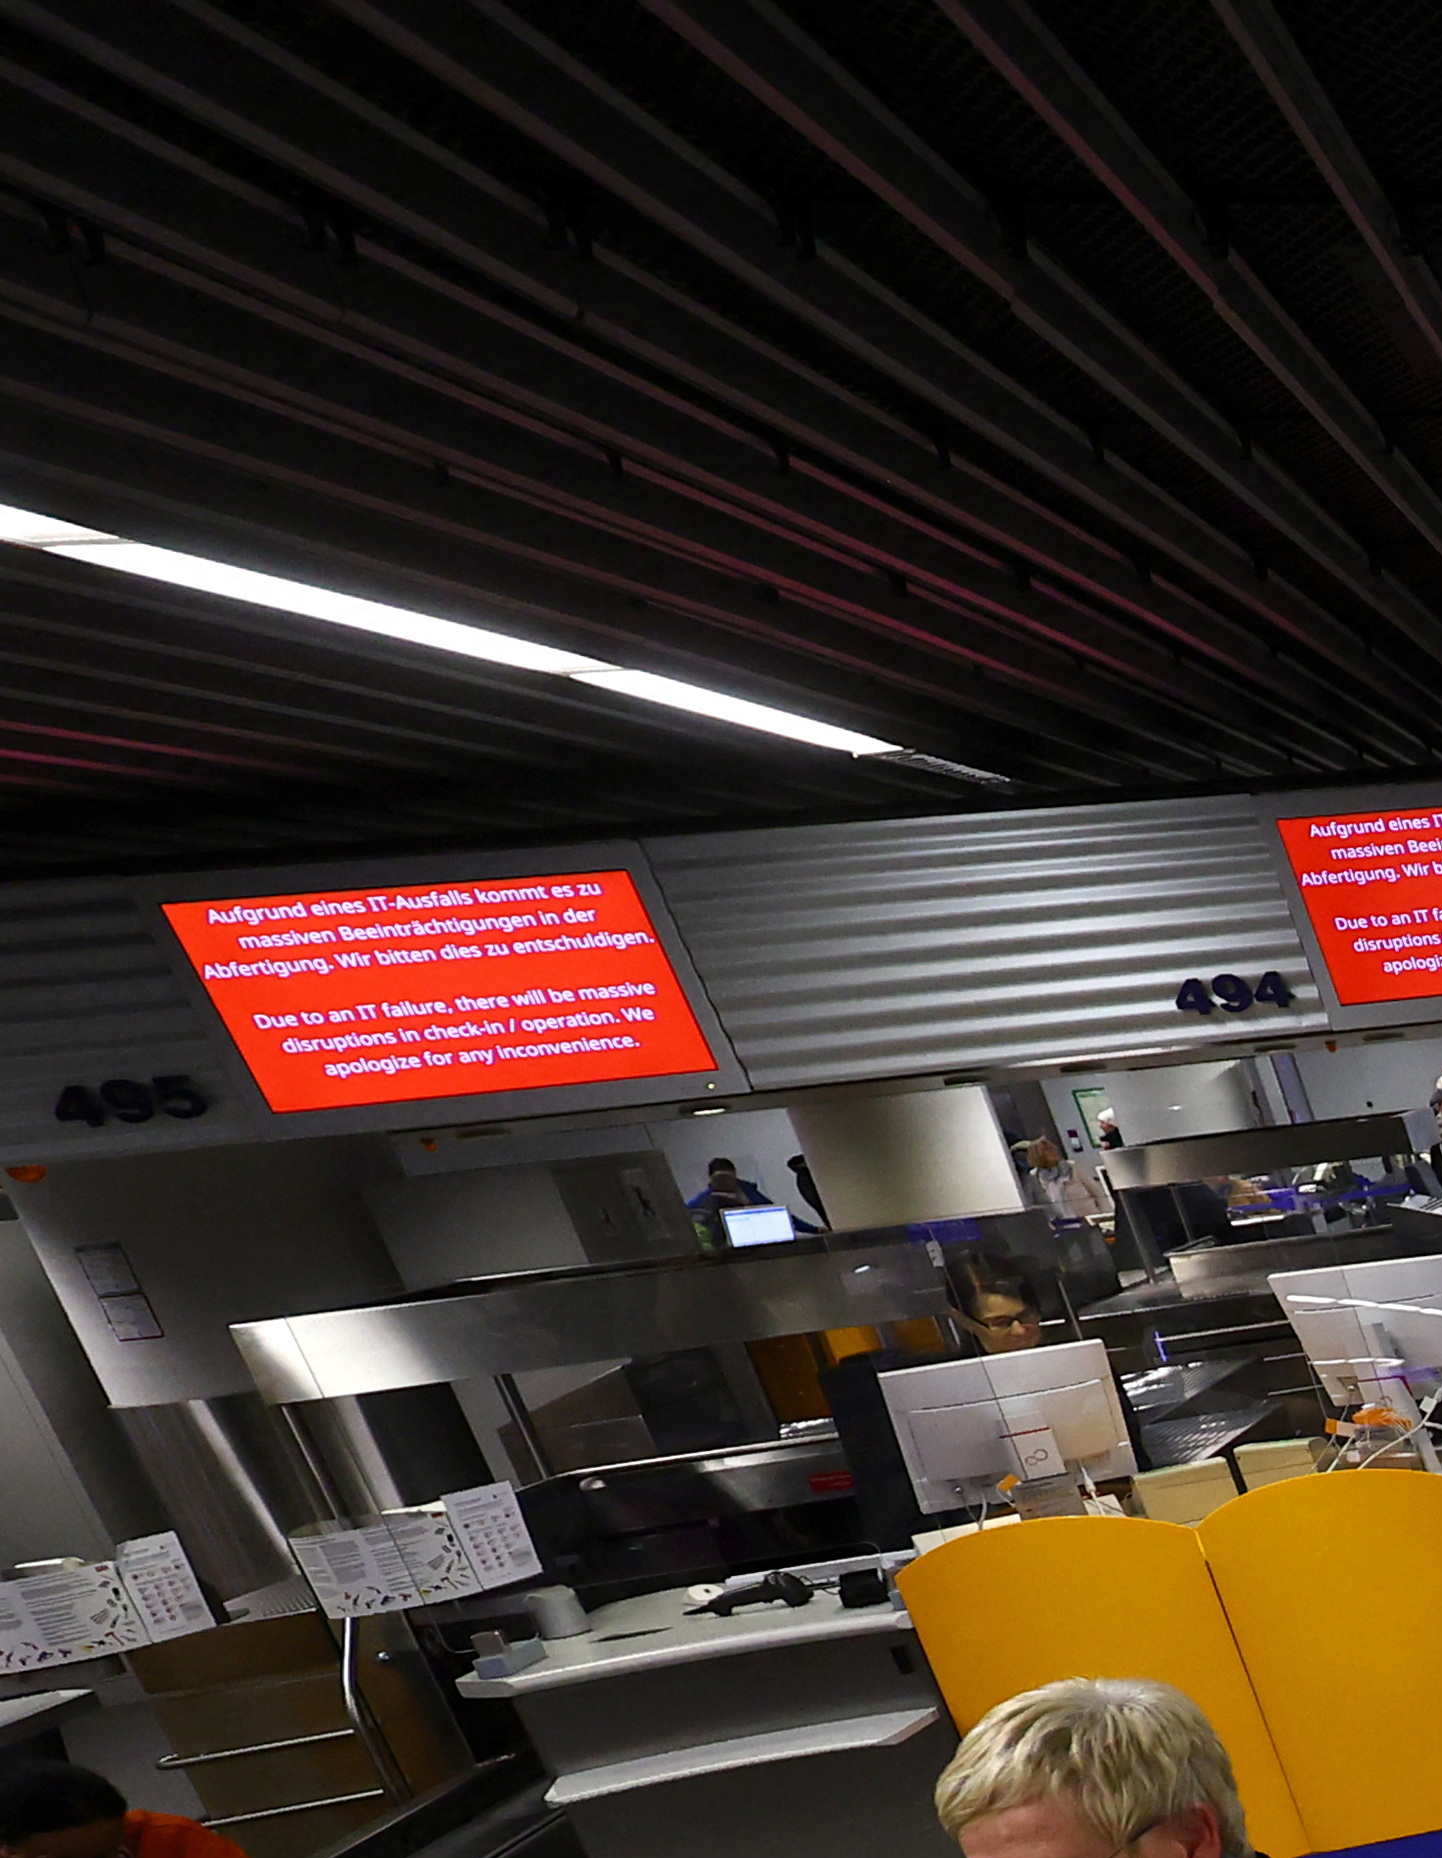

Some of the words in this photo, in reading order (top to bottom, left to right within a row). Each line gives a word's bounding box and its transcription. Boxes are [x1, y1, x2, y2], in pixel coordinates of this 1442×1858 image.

[1310, 818, 1386, 839] Aufgrund
[1388, 817, 1431, 831] eines
[1330, 842, 1405, 860] massiven
[1301, 868, 1401, 887] Abfertigung.
[1401, 862, 1430, 877] Wir
[208, 901, 308, 926] Aufgrund
[310, 900, 367, 916] eines
[366, 889, 474, 912] IT-Ausfalls
[473, 885, 549, 904] kommt
[550, 885, 575, 898] es
[576, 883, 602, 896] zu
[1334, 917, 1369, 931] Due
[1370, 915, 1388, 927] to
[1391, 913, 1412, 926] an
[1412, 909, 1429, 923] IT
[238, 929, 337, 949] massiven
[337, 914, 537, 941] Beeinträchtigungen
[537, 910, 560, 925] in
[562, 907, 595, 924] der
[1353, 933, 1442, 952] disruptions
[204, 958, 335, 980] Abfertigung.
[333, 952, 371, 968] Wir
[373, 949, 437, 965] bitten
[439, 944, 483, 960] dies
[484, 943, 510, 957] zu
[512, 931, 655, 954] entschuldigen.
[253, 1014, 299, 1029] Due
[300, 1011, 325, 1025] to
[328, 1009, 356, 1023] an
[355, 1004, 377, 1020] IT
[381, 1000, 453, 1018] failure,
[454, 995, 510, 1012] there
[510, 989, 547, 1006] will
[547, 988, 576, 1003] be
[577, 981, 656, 1001] massive
[1175, 971, 1296, 1015] 494
[282, 1032, 398, 1053] disruptions
[397, 1028, 421, 1043] in
[423, 1020, 506, 1041] check-in
[508, 1017, 516, 1034] /
[521, 1011, 621, 1034] operation.
[620, 1006, 655, 1022] We
[324, 1054, 422, 1079] apologize
[423, 1051, 453, 1066] for
[458, 1049, 493, 1065] any
[495, 1036, 640, 1059] inconvenience.
[56, 1075, 208, 1128] 495
